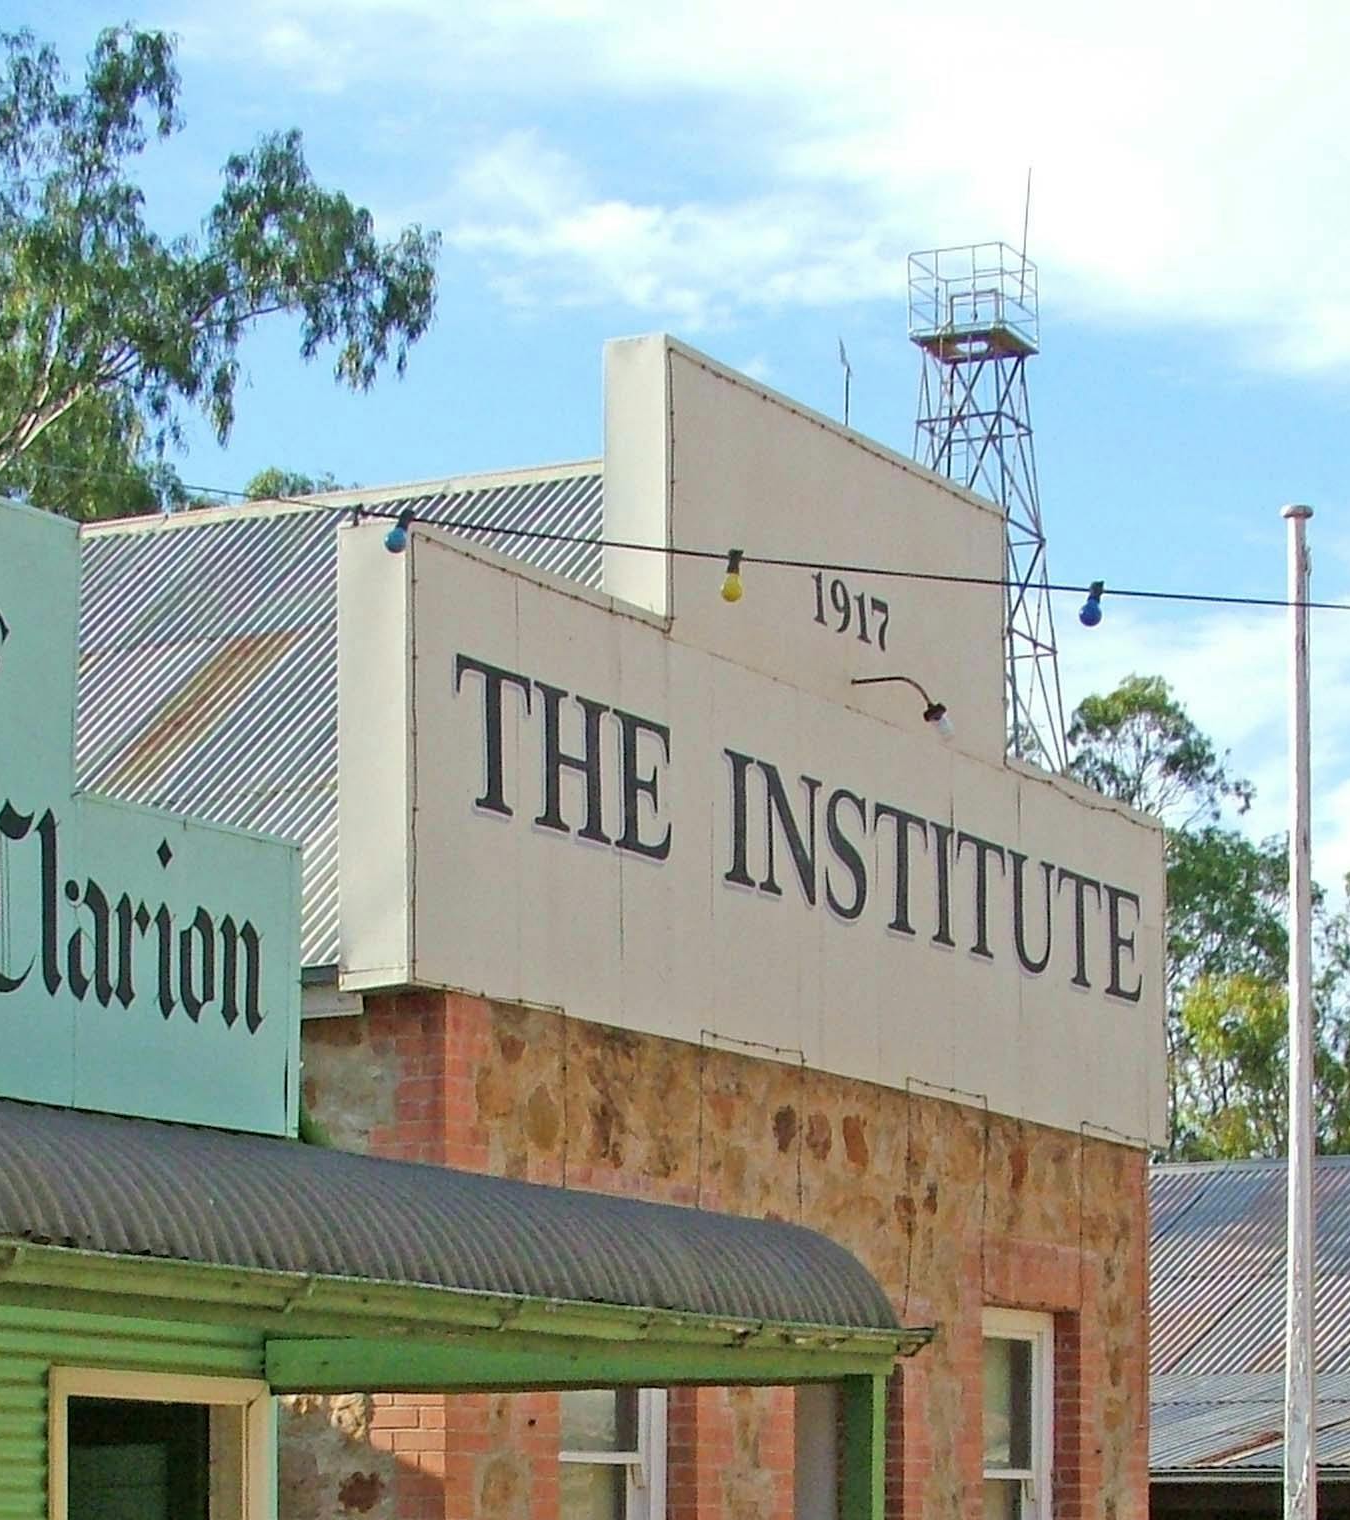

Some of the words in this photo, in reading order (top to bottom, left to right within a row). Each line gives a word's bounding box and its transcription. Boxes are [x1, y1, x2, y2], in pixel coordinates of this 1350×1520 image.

[811, 570, 892, 652] 1917
[453, 651, 673, 863] THE
[723, 746, 1144, 1003] INSTITUTE
